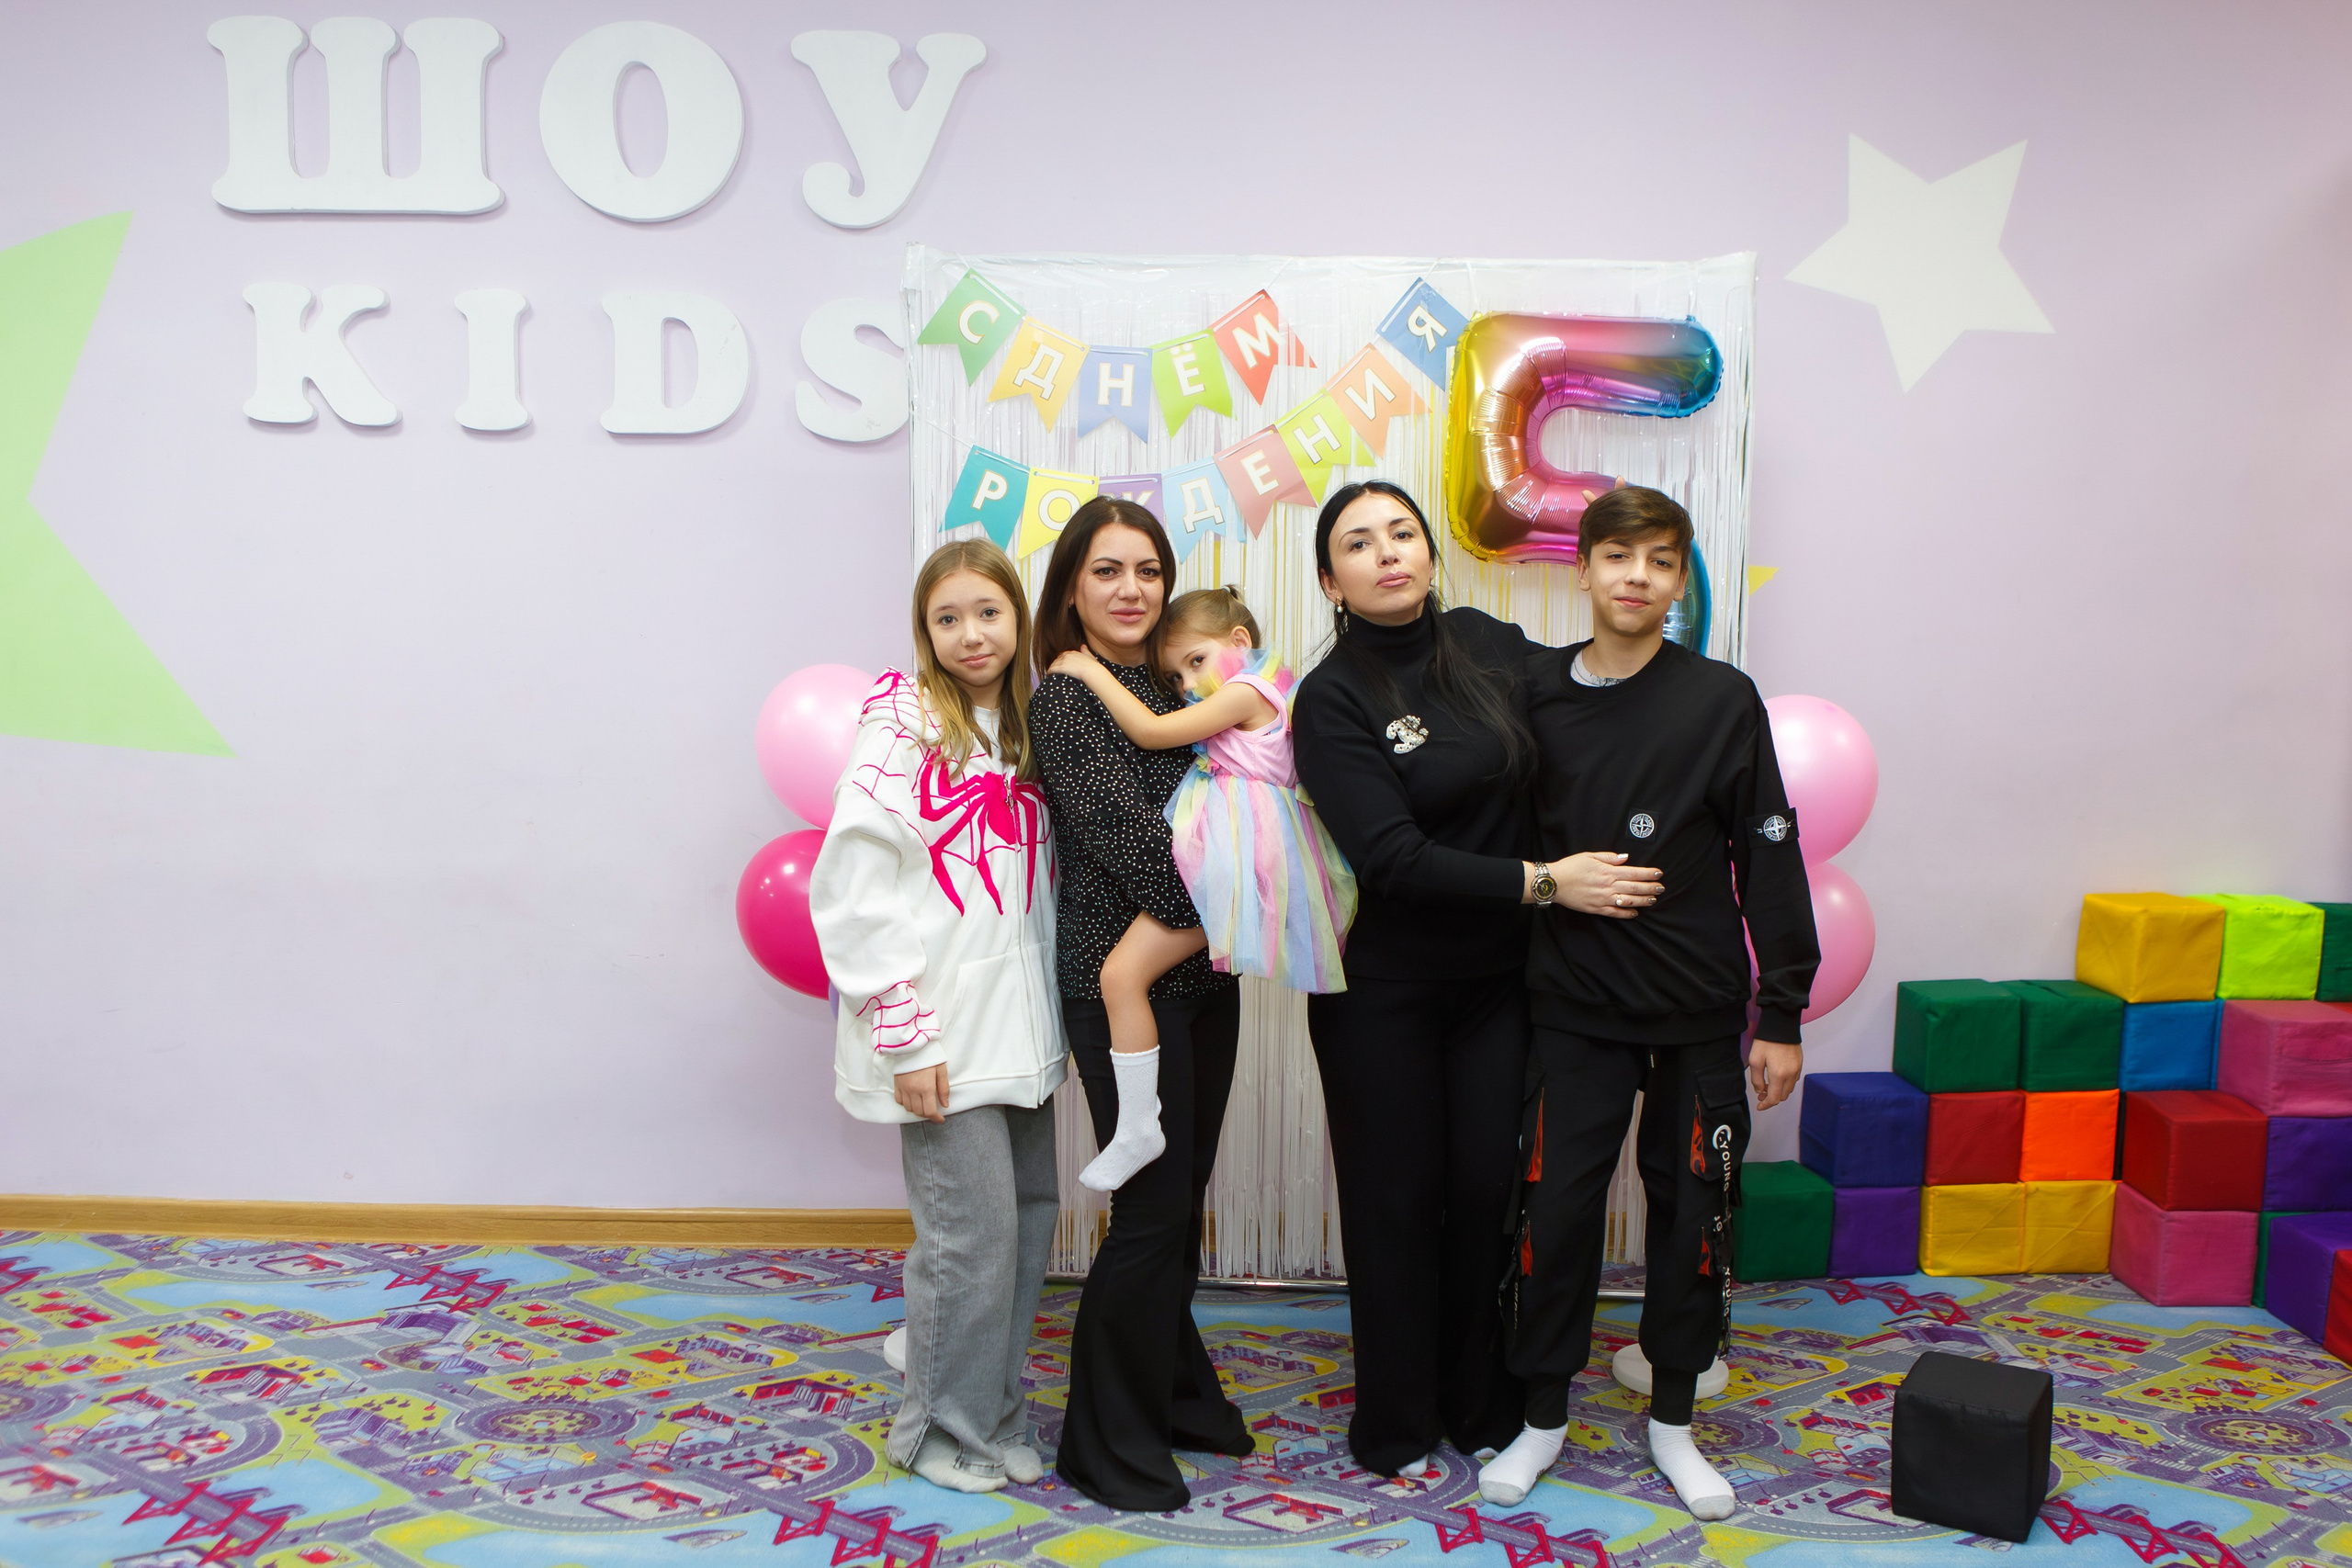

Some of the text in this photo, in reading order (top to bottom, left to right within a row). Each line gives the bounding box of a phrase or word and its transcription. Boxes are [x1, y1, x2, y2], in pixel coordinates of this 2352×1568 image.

[207, 17, 988, 229] ШОУ
[243, 282, 910, 444] KIDS
[958, 300, 1286, 407] С ДНЁМ
